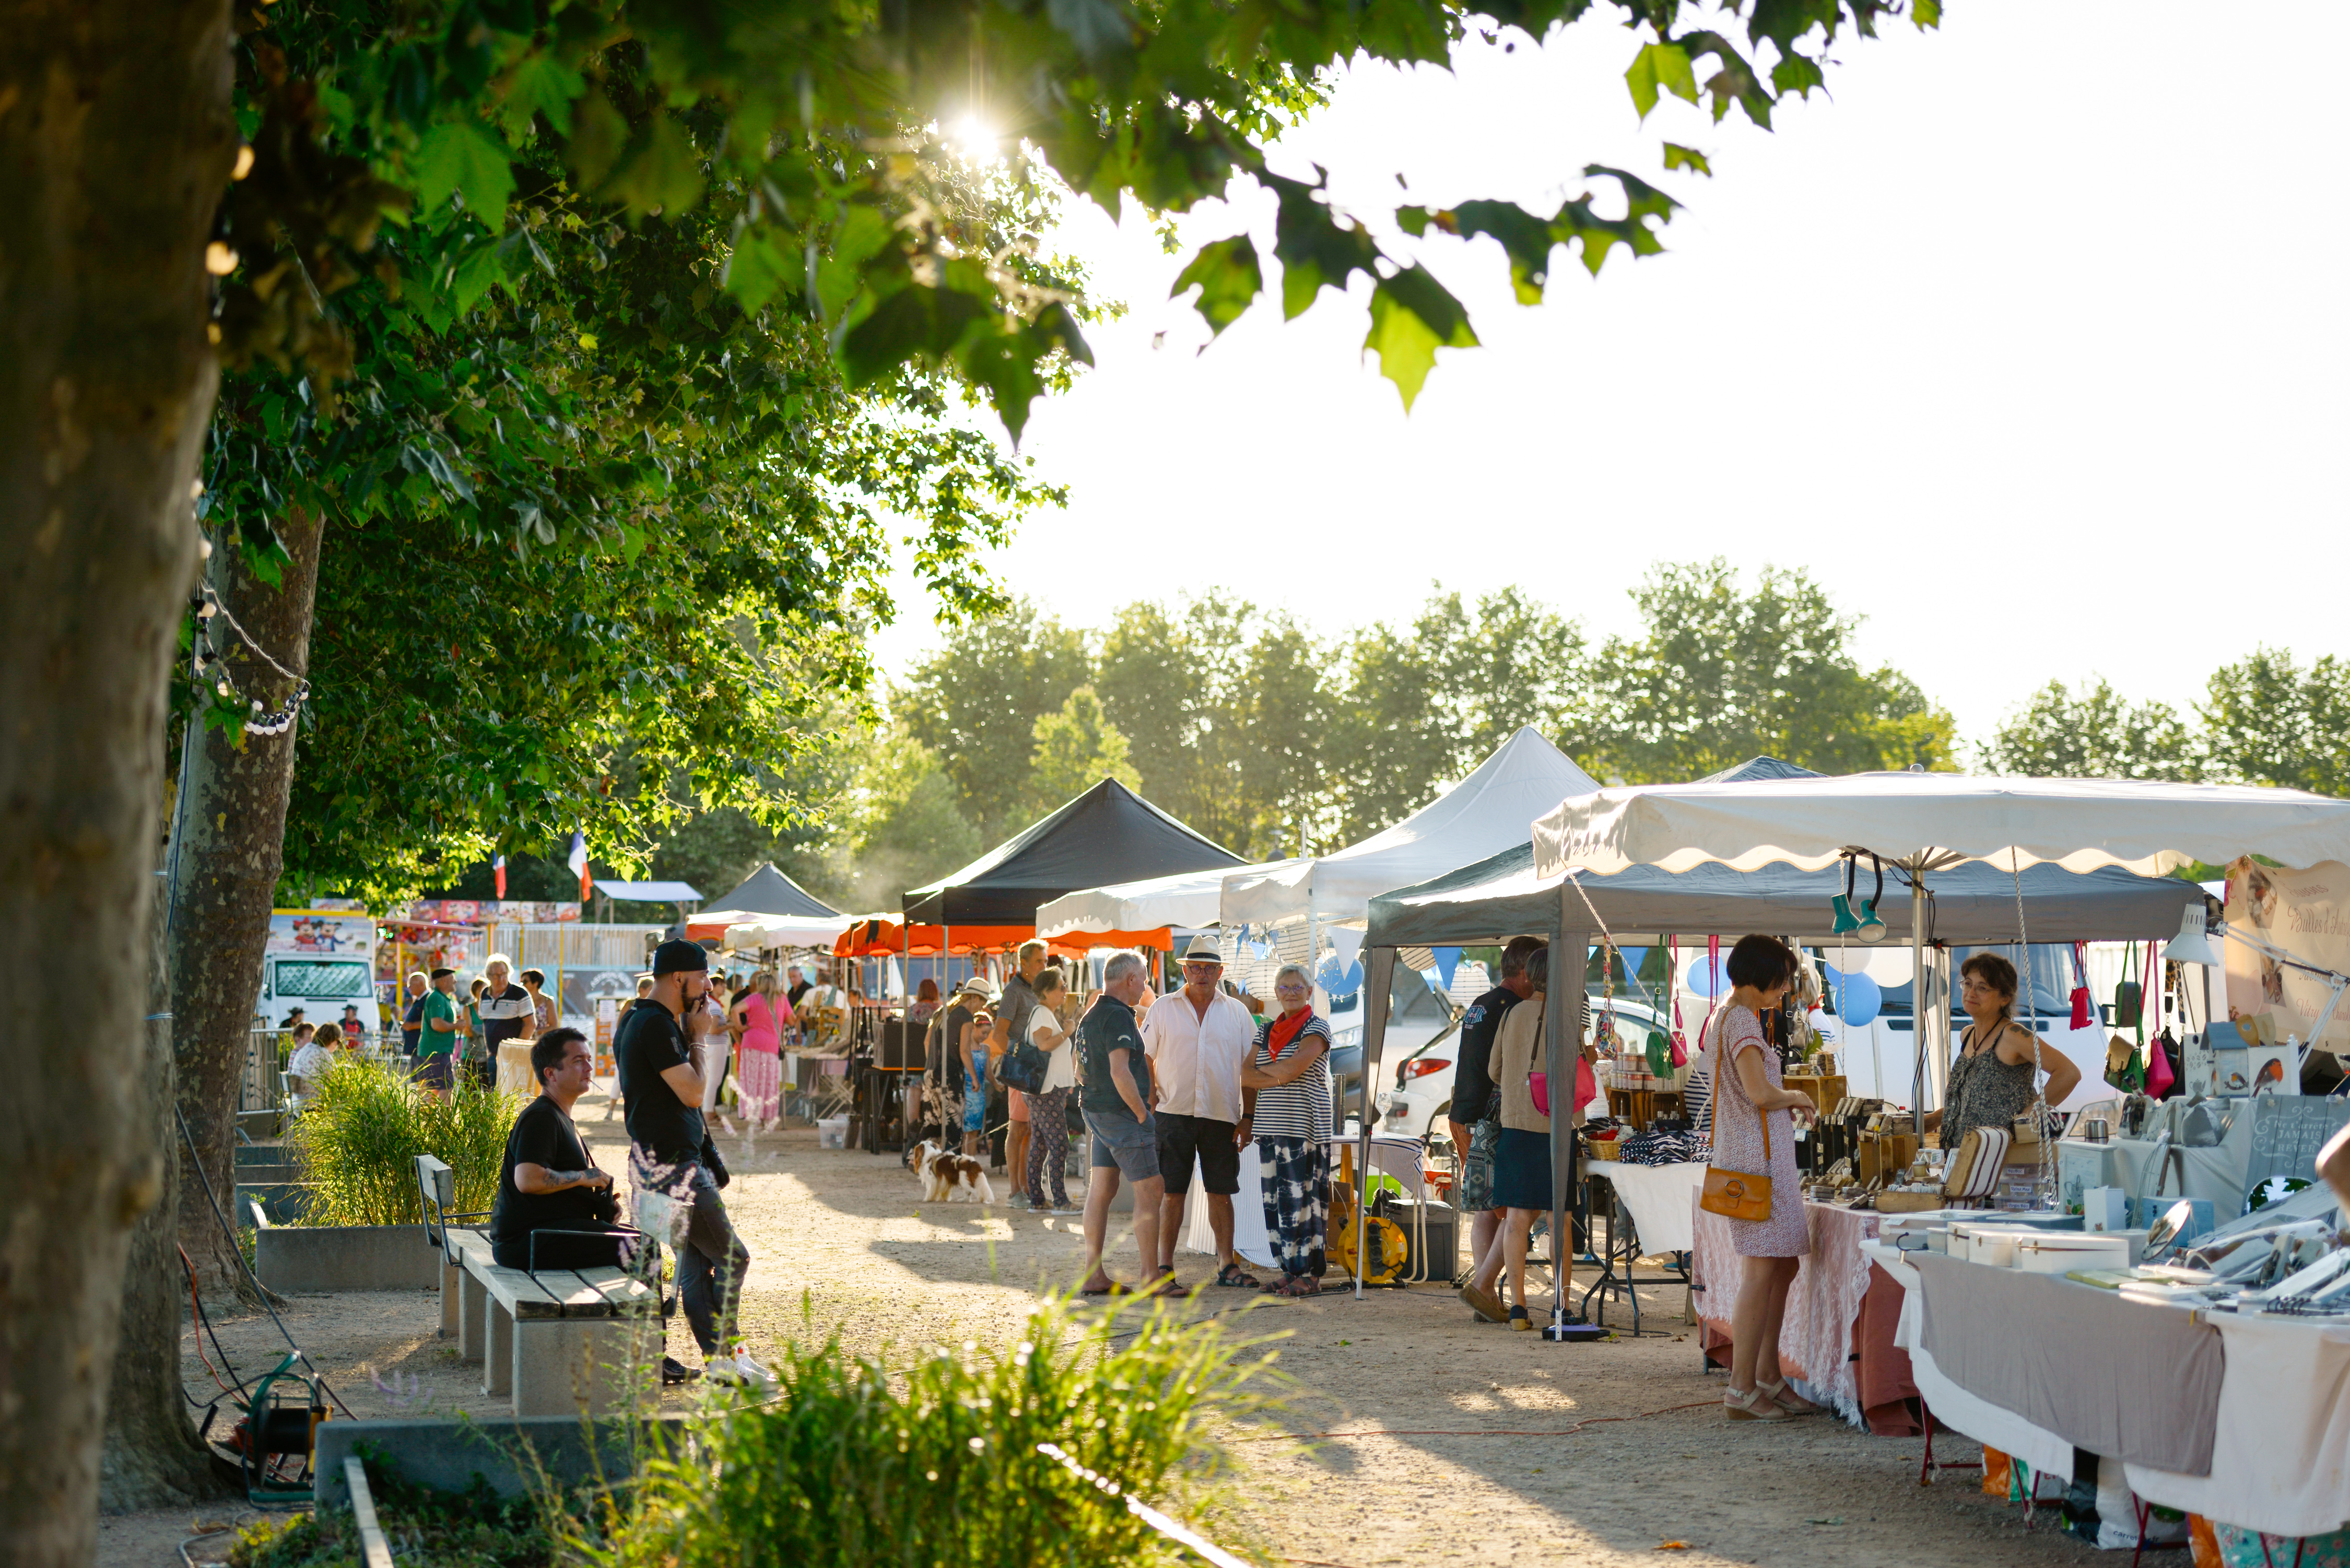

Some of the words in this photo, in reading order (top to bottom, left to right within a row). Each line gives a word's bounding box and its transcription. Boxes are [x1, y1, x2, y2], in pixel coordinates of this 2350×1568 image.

[2287, 905, 2322, 933] Bulles
[2296, 998, 2319, 1024] Vitry
[2274, 1120, 2287, 1128] Ne
[2277, 1129, 2321, 1139] JAMAIS
